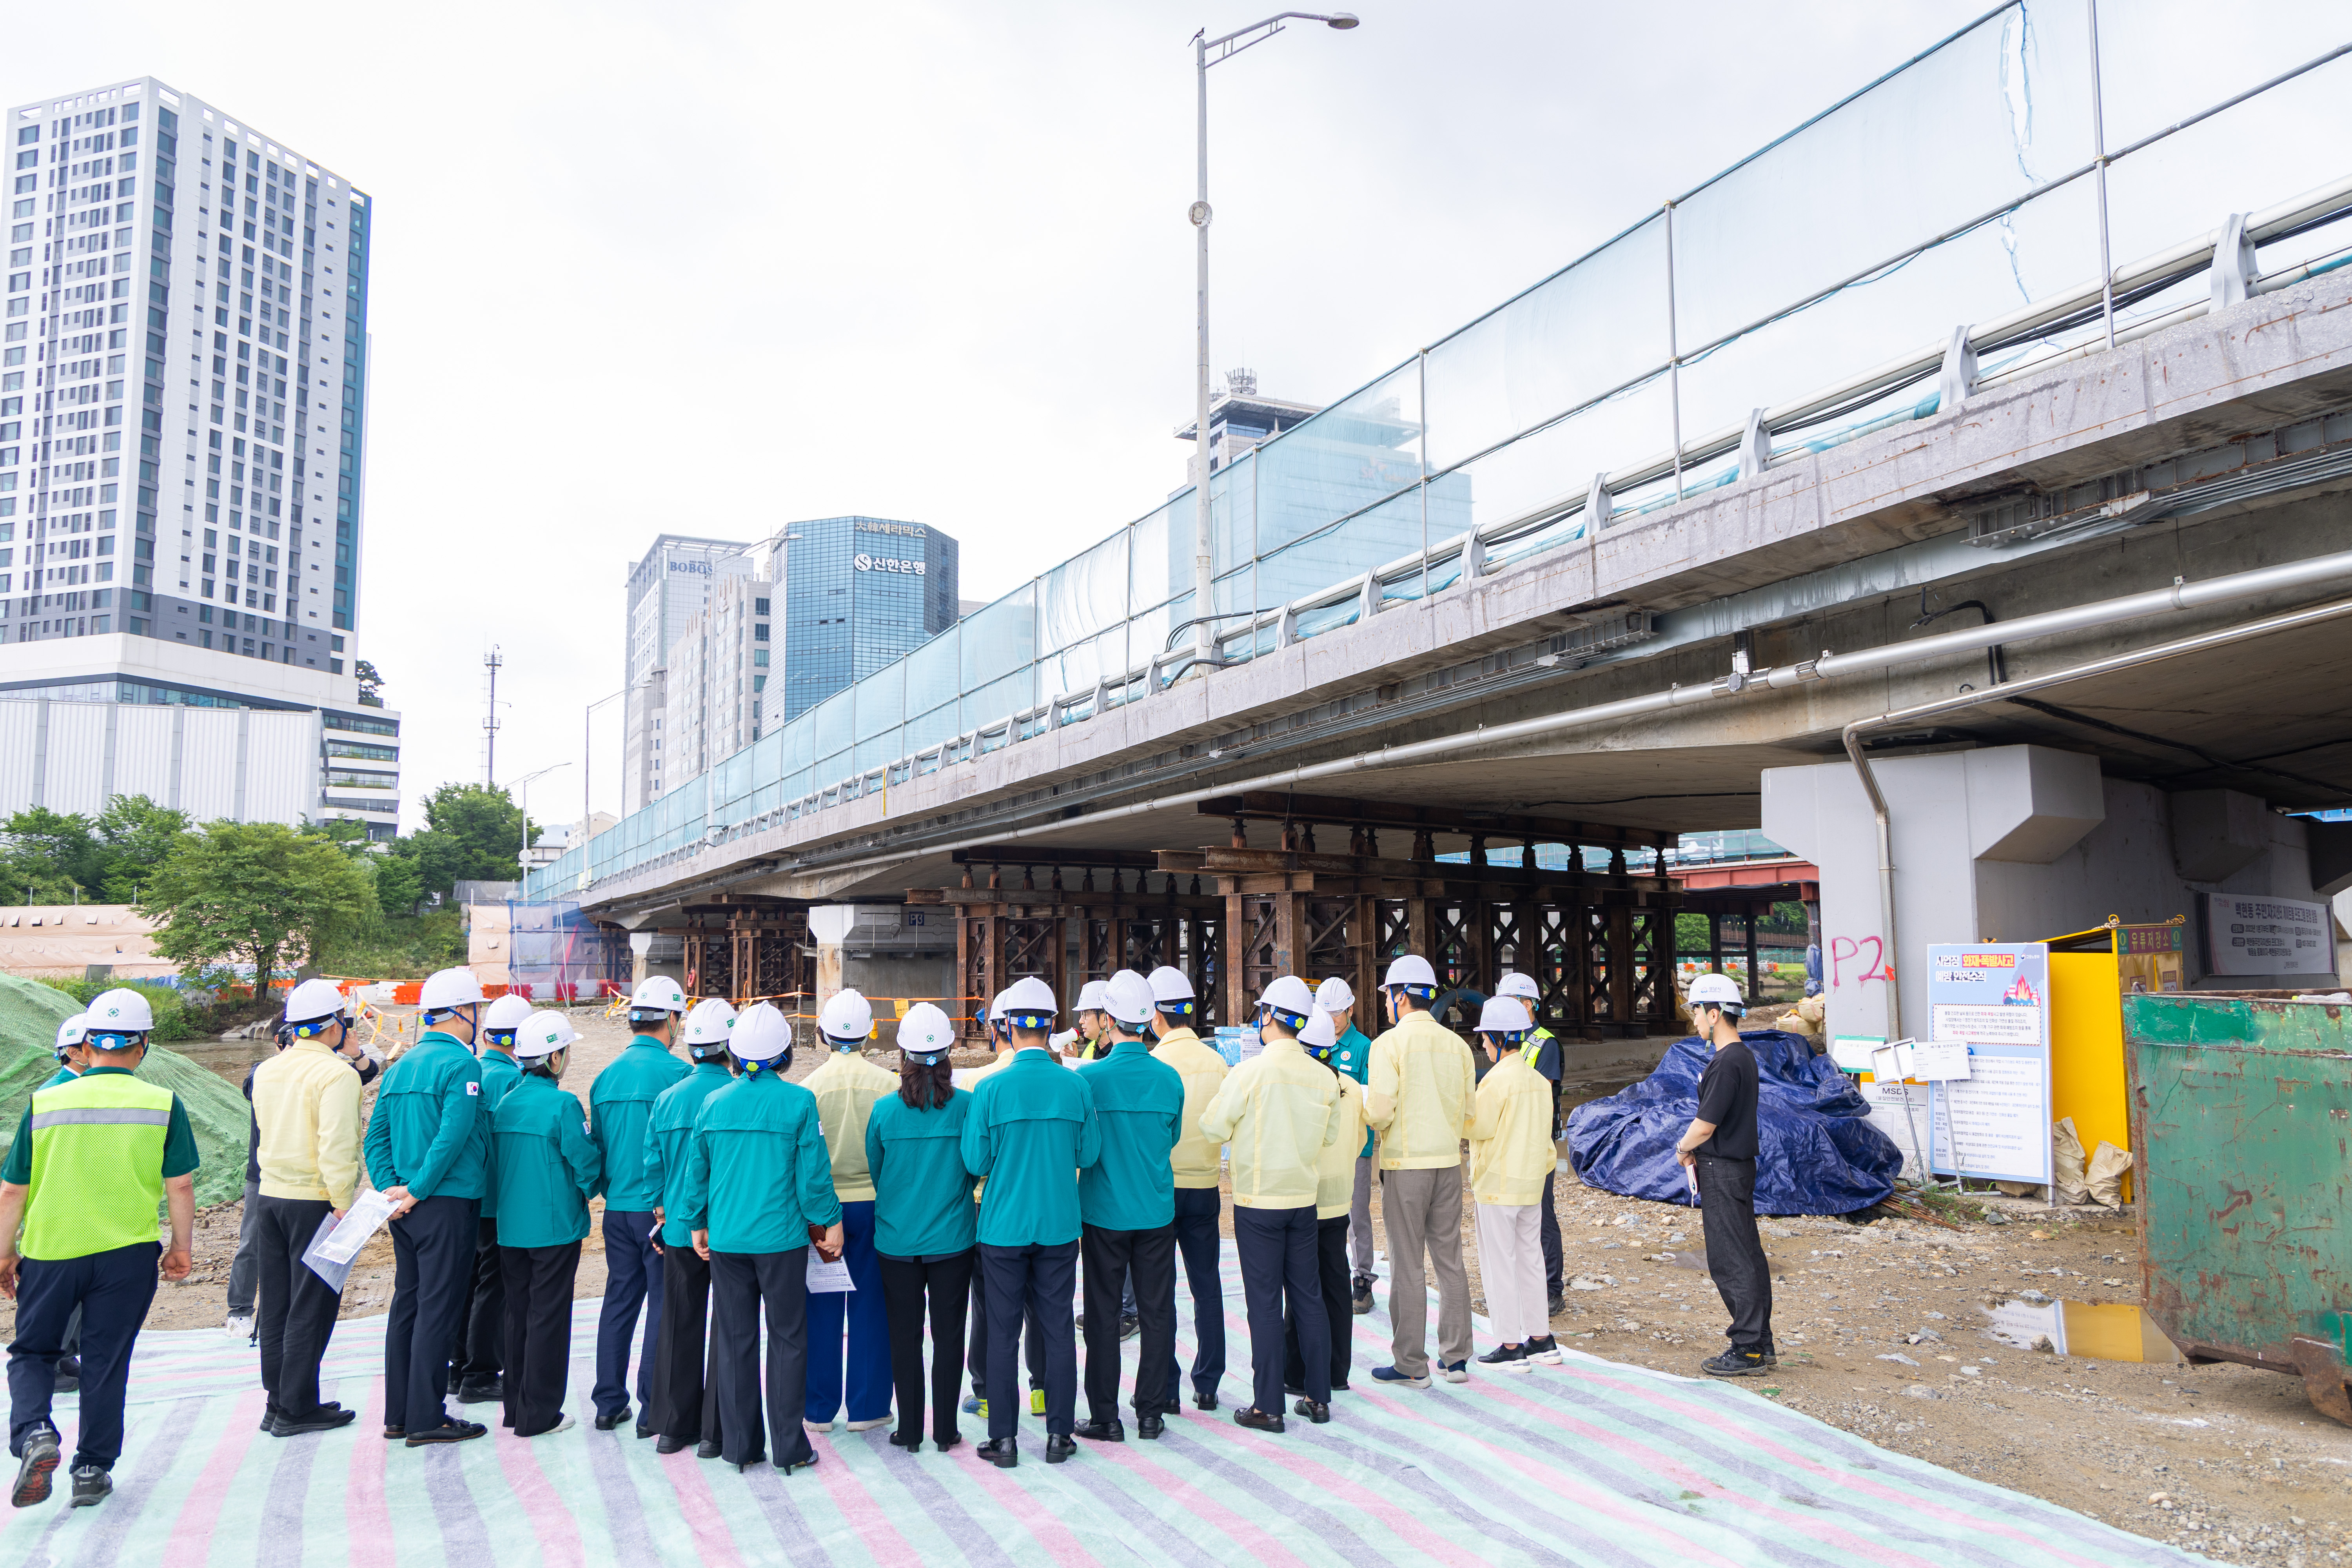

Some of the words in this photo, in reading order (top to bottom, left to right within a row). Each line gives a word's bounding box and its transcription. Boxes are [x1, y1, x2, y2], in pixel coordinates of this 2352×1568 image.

[669, 561, 712, 575] BOBOS
[873, 557, 926, 575] 신한은행
[2235, 902, 2253, 918] 백현동
[2256, 903, 2282, 920] 주민자치센터
[910, 914, 923, 925] P3
[2132, 931, 2169, 950] 유류저장소
[1831, 935, 1886, 993] P2
[1935, 955, 1960, 967] 사업장
[1962, 955, 2014, 967] 화재·폭발사고
[1935, 971, 1952, 982] 예방
[1953, 971, 1987, 982] 안전수칙
